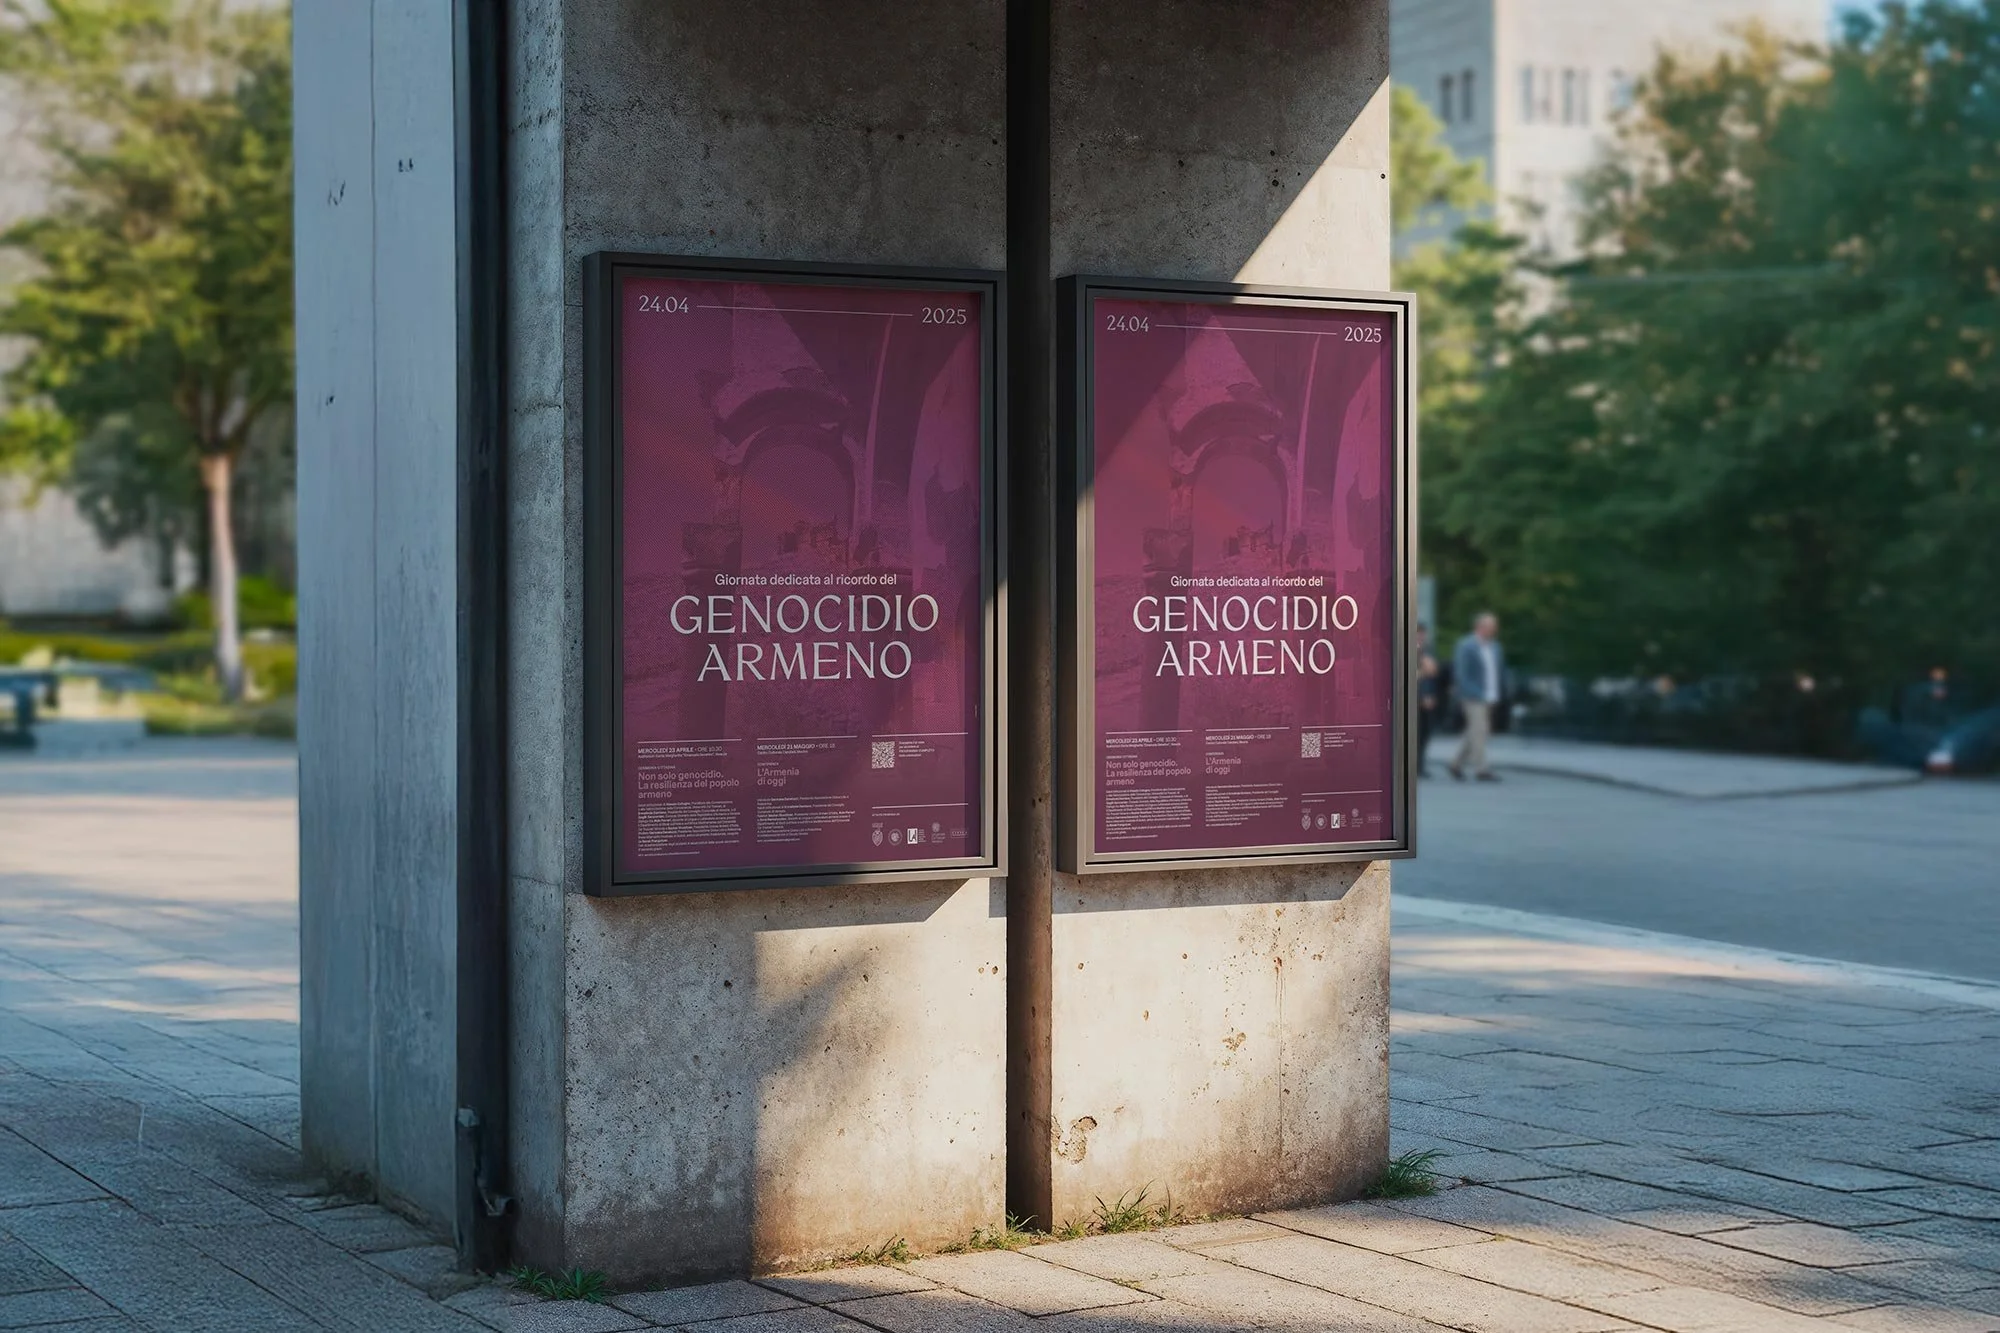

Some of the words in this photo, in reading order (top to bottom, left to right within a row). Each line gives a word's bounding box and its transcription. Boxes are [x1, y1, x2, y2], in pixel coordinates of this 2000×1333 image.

[639, 295, 689, 314] 24.04
[922, 307, 967, 325] 2025
[1107, 315, 1149, 333] 24.04
[1344, 327, 1382, 343] 2025
[715, 573, 767, 586] Giornata
[769, 573, 821, 586] dedicata
[824, 574, 833, 585] al
[836, 573, 877, 585] ricordo
[880, 573, 896, 585] del
[1171, 576, 1214, 587] Giornata
[1216, 576, 1259, 587] dedicata
[1261, 576, 1270, 587] al
[1272, 576, 1306, 587] ricordo
[1308, 576, 1323, 587] del
[670, 594, 939, 635] GENOCIDIO
[1132, 595, 1359, 632] GENOCIDIO
[697, 640, 912, 682] ARMENO
[1156, 638, 1336, 677] ARMENO
[1123, 760, 1138, 768] solo
[1214, 765, 1230, 775] oggi
[638, 772, 656, 781] Non
[658, 771, 676, 780] solo
[678, 770, 724, 781] genocidio.
[1116, 768, 1152, 776] resilienza
[1166, 767, 1191, 776] popolo
[638, 782, 649, 790] La
[650, 781, 693, 789] resilienza
[694, 779, 707, 788] del
[709, 778, 740, 789] popolo
[757, 777, 765, 785] di
[767, 777, 786, 786] oggi
[638, 791, 672, 799] armeno
